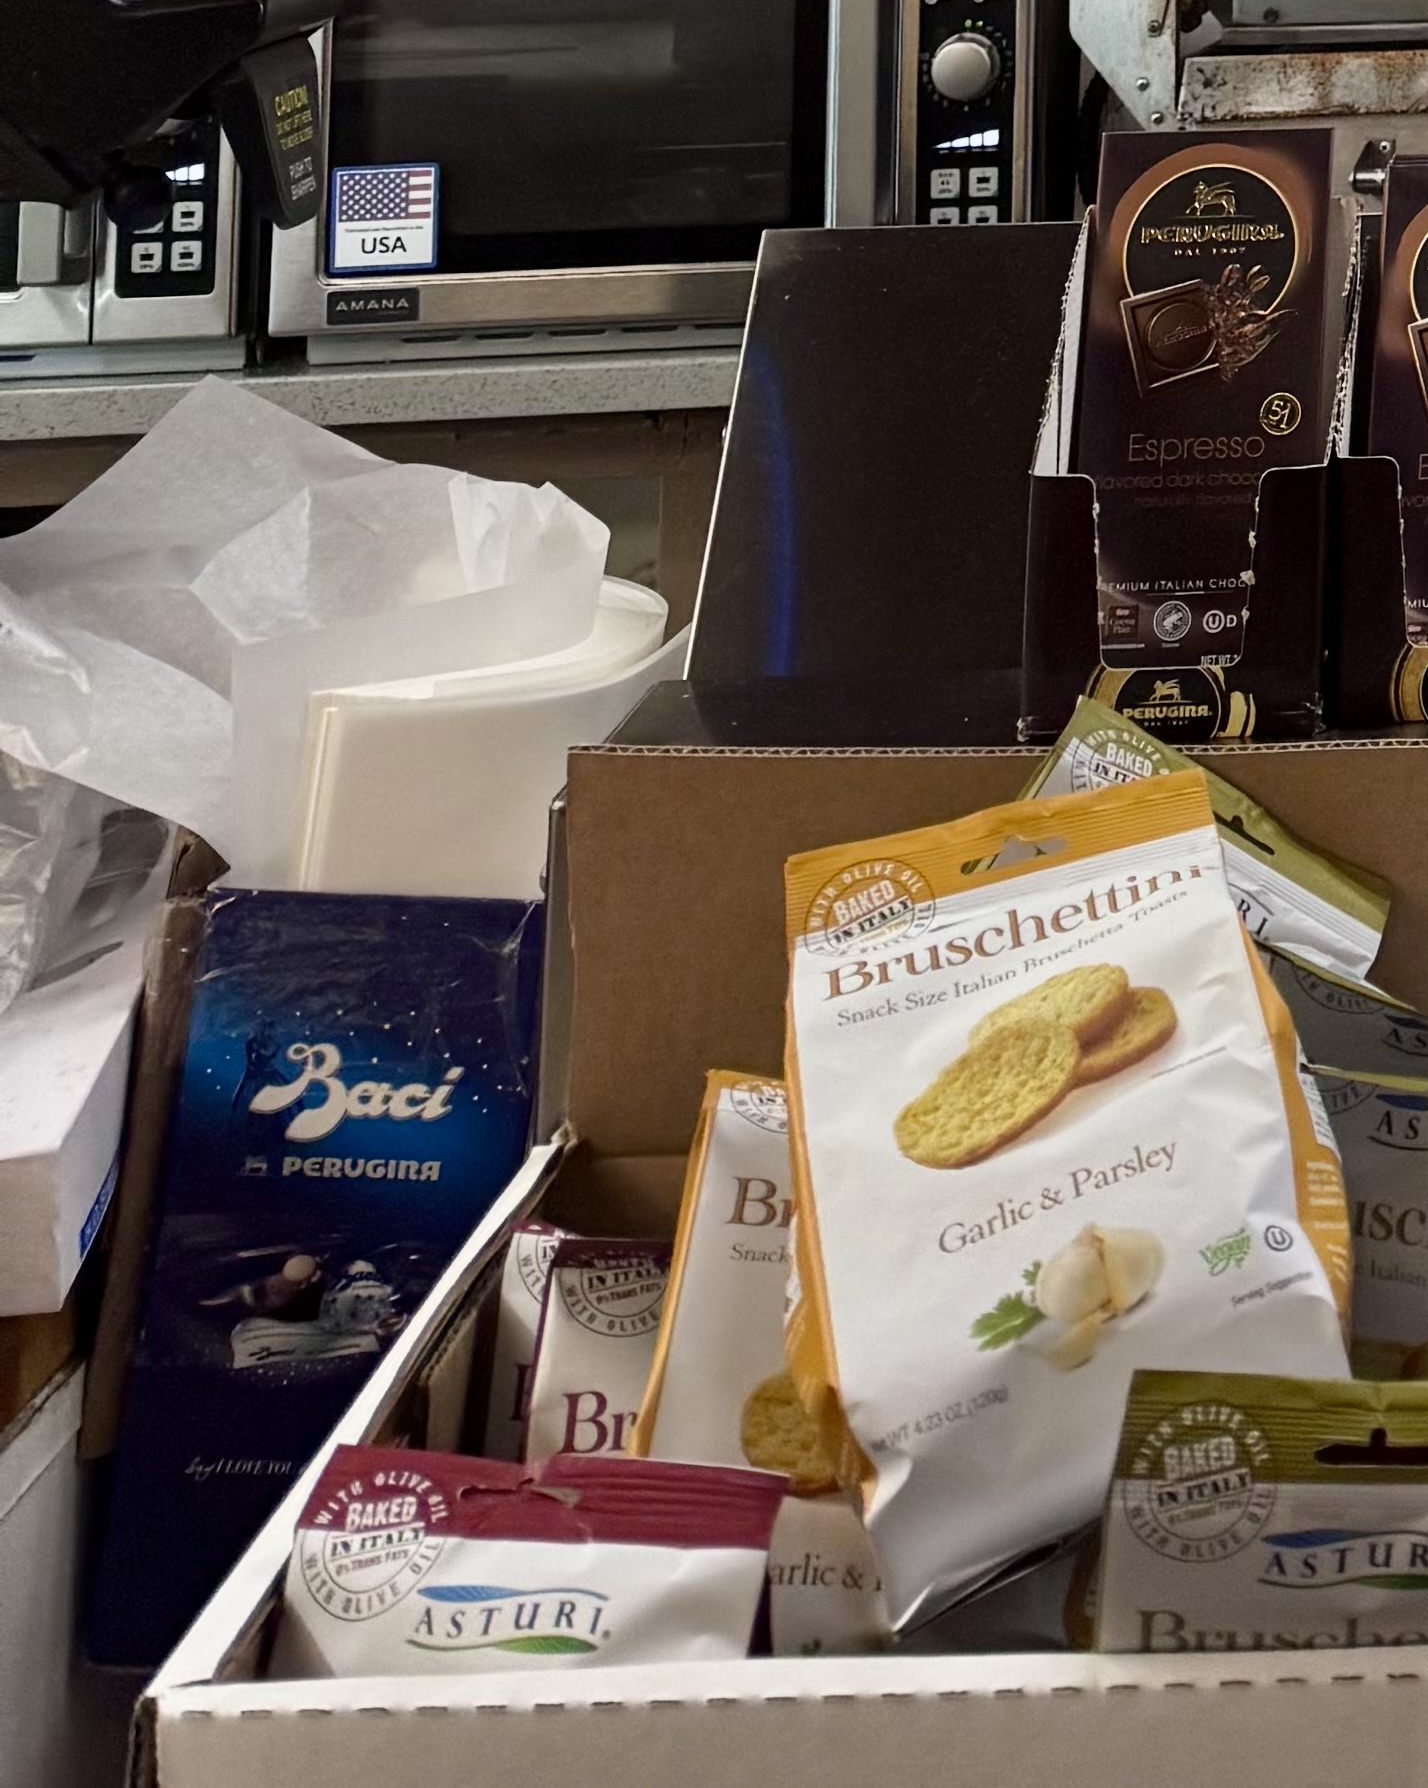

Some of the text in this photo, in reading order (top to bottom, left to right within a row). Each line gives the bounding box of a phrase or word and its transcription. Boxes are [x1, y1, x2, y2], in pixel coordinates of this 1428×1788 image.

[361, 236, 407, 254] USA
[1140, 222, 1284, 245] PERUGINA
[336, 298, 409, 311] AMANA
[1127, 433, 1266, 465] Espresso
[832, 880, 895, 923] BAKED
[822, 864, 1202, 1001] Bruschettini
[248, 1042, 463, 1142] Baci
[936, 1140, 1180, 1256] Garlic & Parsley
[1198, 1231, 1253, 1276] Vegan
[346, 1496, 417, 1530] BAKED
[414, 1599, 602, 1639] ASTURI
